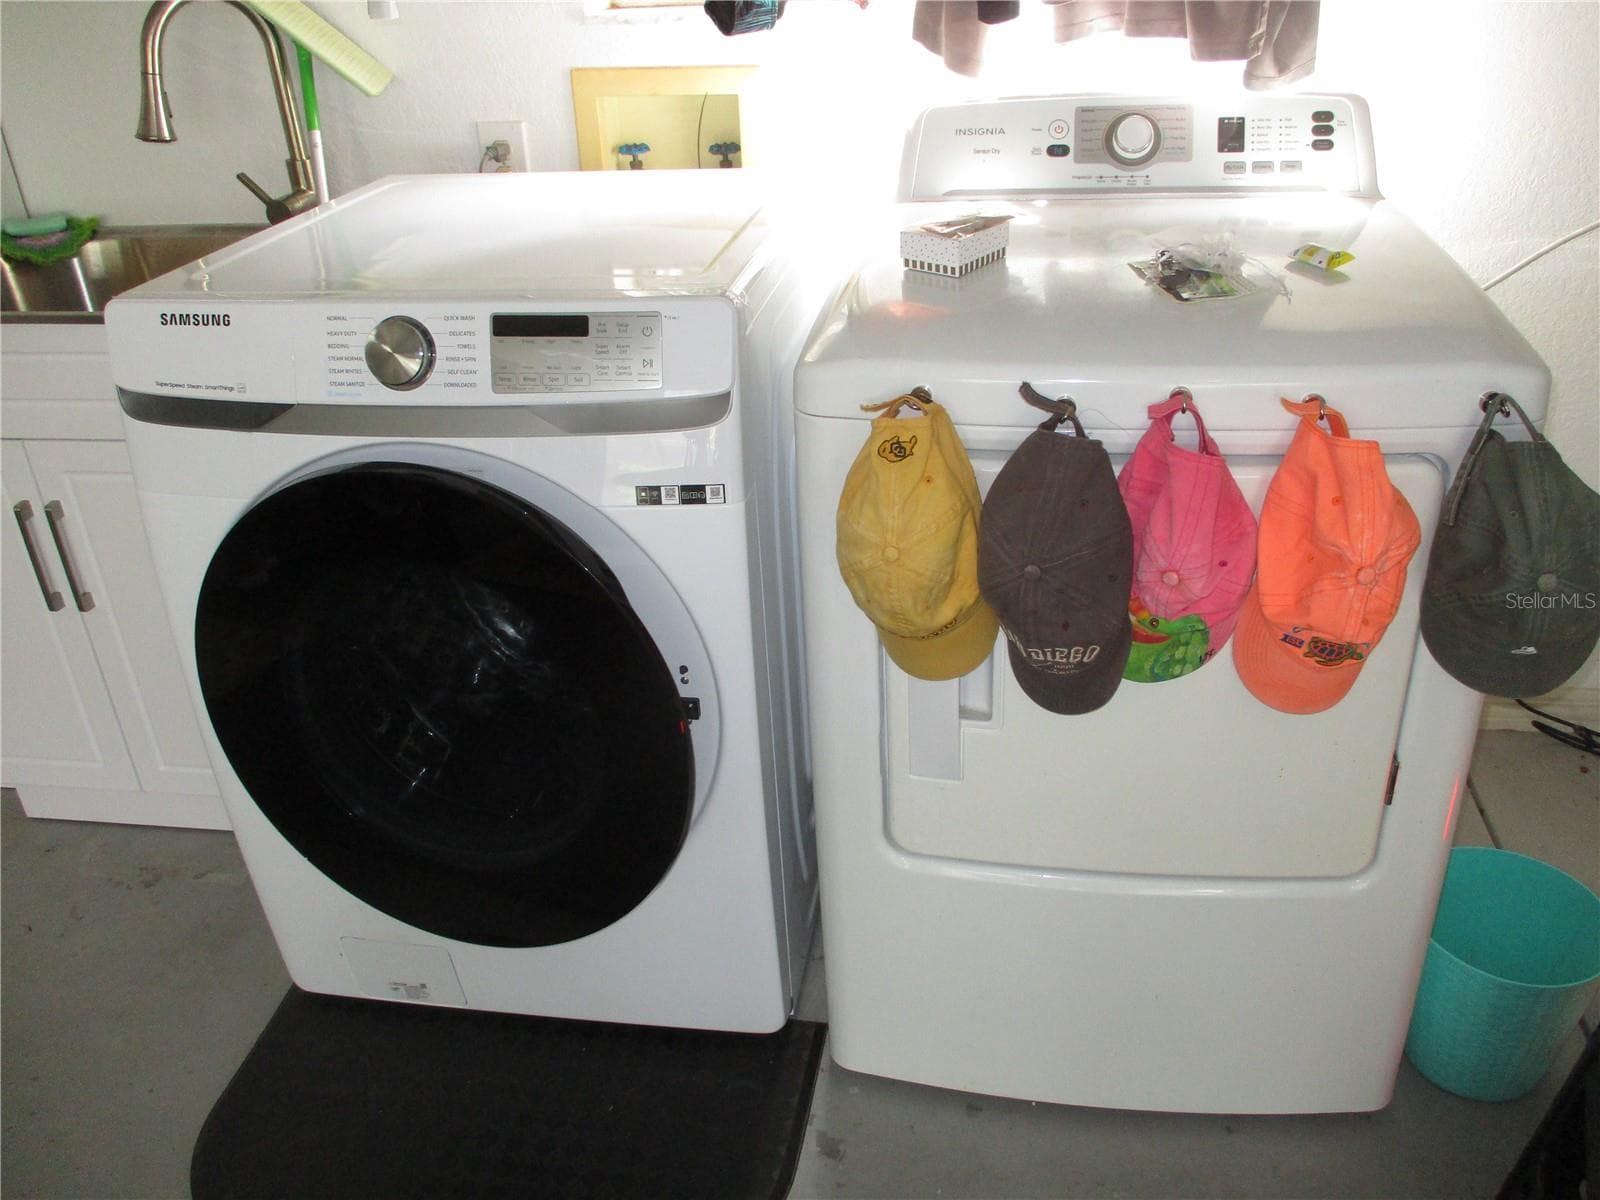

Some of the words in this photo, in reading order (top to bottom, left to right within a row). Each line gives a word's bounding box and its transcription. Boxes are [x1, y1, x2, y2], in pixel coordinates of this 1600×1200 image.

[955, 127, 1006, 136] INSIGNIA
[160, 313, 231, 327] SAMSUNG
[1027, 645, 1101, 663] DIEGO
